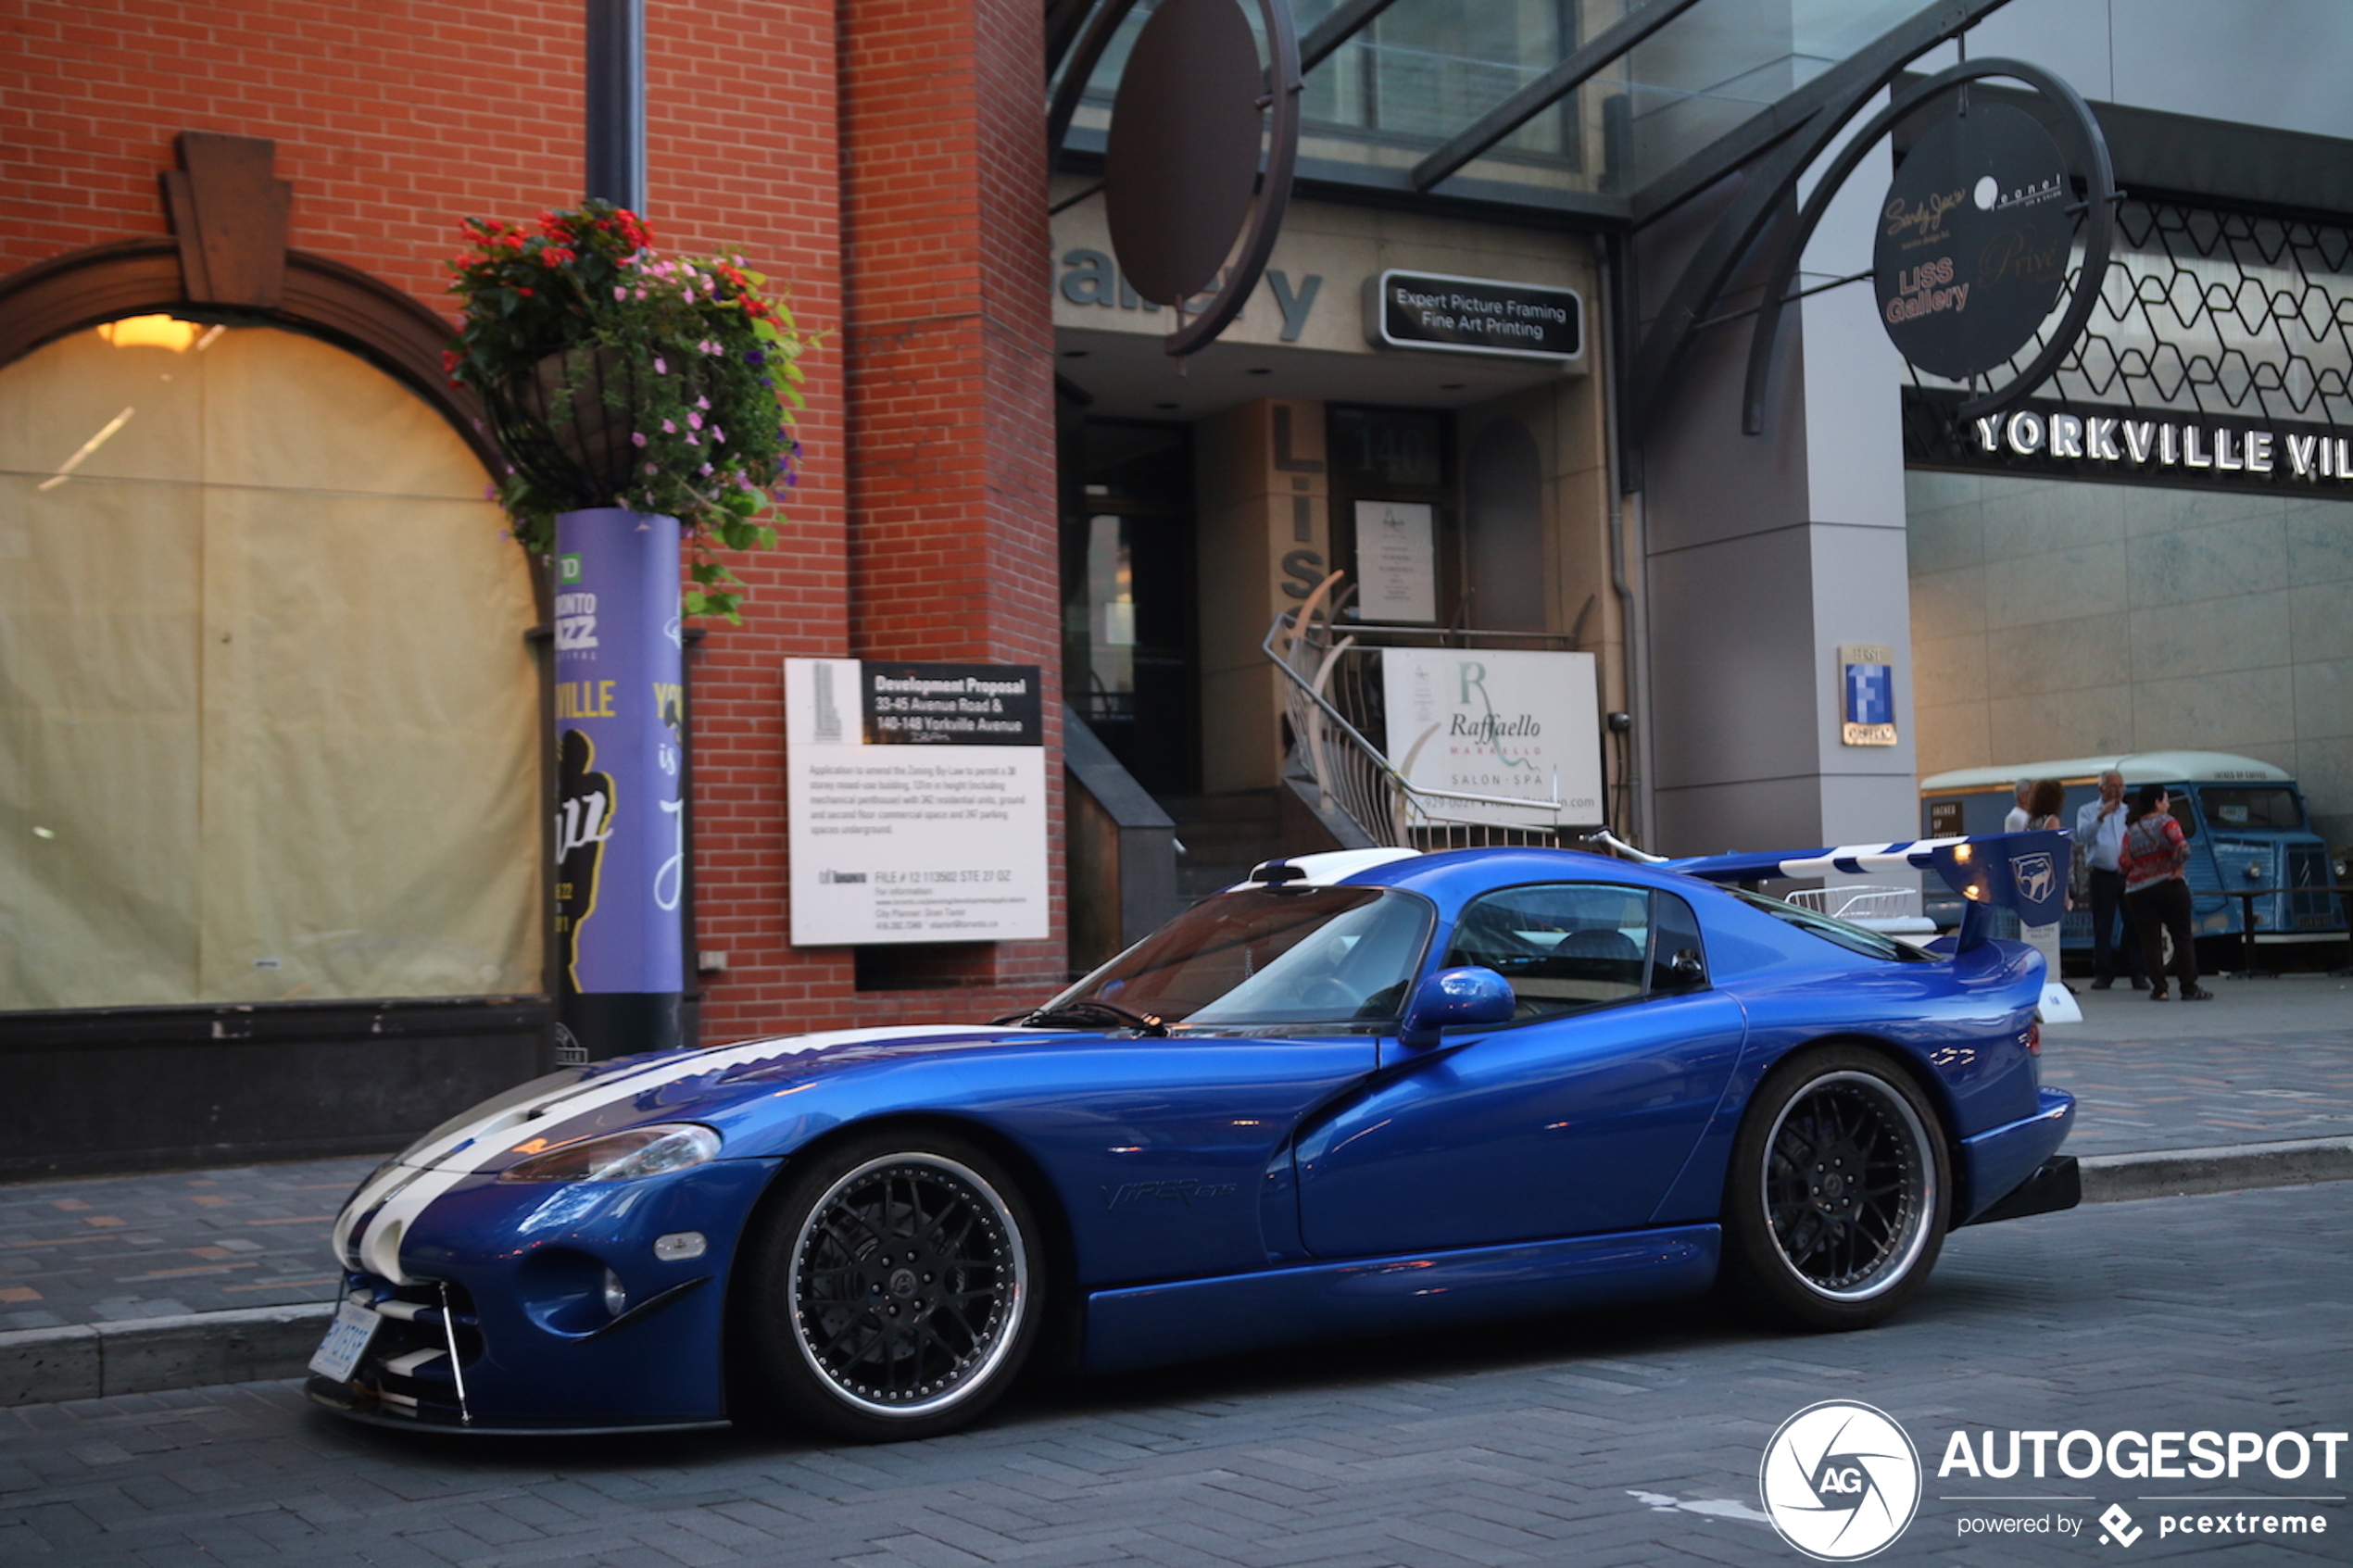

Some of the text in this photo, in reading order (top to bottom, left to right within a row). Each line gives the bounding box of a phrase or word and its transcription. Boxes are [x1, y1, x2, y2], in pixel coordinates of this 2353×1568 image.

[1899, 257, 1955, 295] LISS
[1396, 288, 1567, 323] Expert Picture Framing
[1886, 283, 1969, 323] Gallery
[1421, 311, 1544, 340] Fine Art Printing
[1977, 409, 2274, 472] YORKVILLE
[874, 675, 1027, 696] Development Proposal
[875, 696, 1003, 713] 33-45 Avenue Road &
[876, 716, 1023, 733] 140-148 Yorkville Avenue
[1449, 713, 1541, 745] Raffaello
[659, 743, 676, 775] is
[1452, 774, 1543, 785] SALON SPA
[875, 871, 897, 884] FILE
[909, 871, 920, 884] 12
[961, 870, 980, 883] STE
